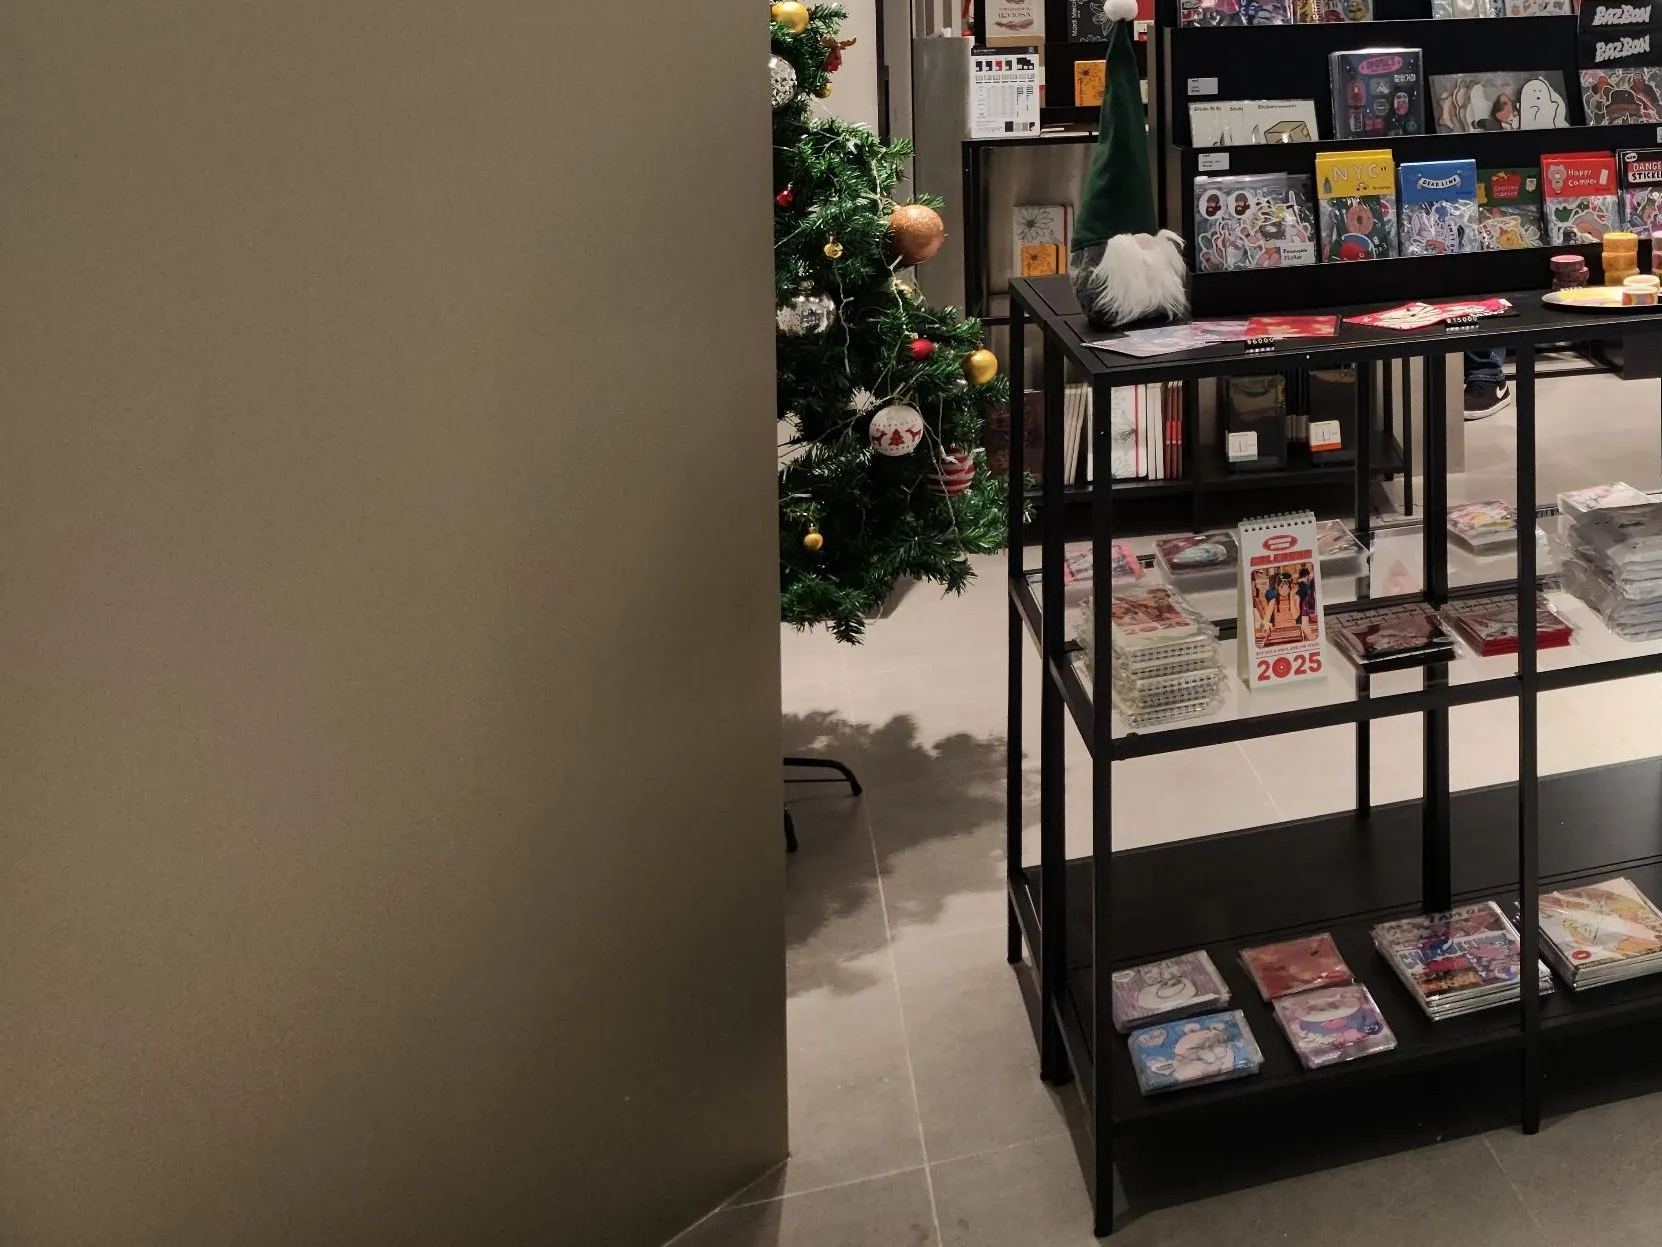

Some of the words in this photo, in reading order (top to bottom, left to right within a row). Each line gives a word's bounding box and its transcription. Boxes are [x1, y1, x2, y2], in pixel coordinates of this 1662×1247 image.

[1333, 163, 1379, 182] NYC
[1568, 168, 1592, 178] Happy
[1257, 652, 1322, 682] 2025
